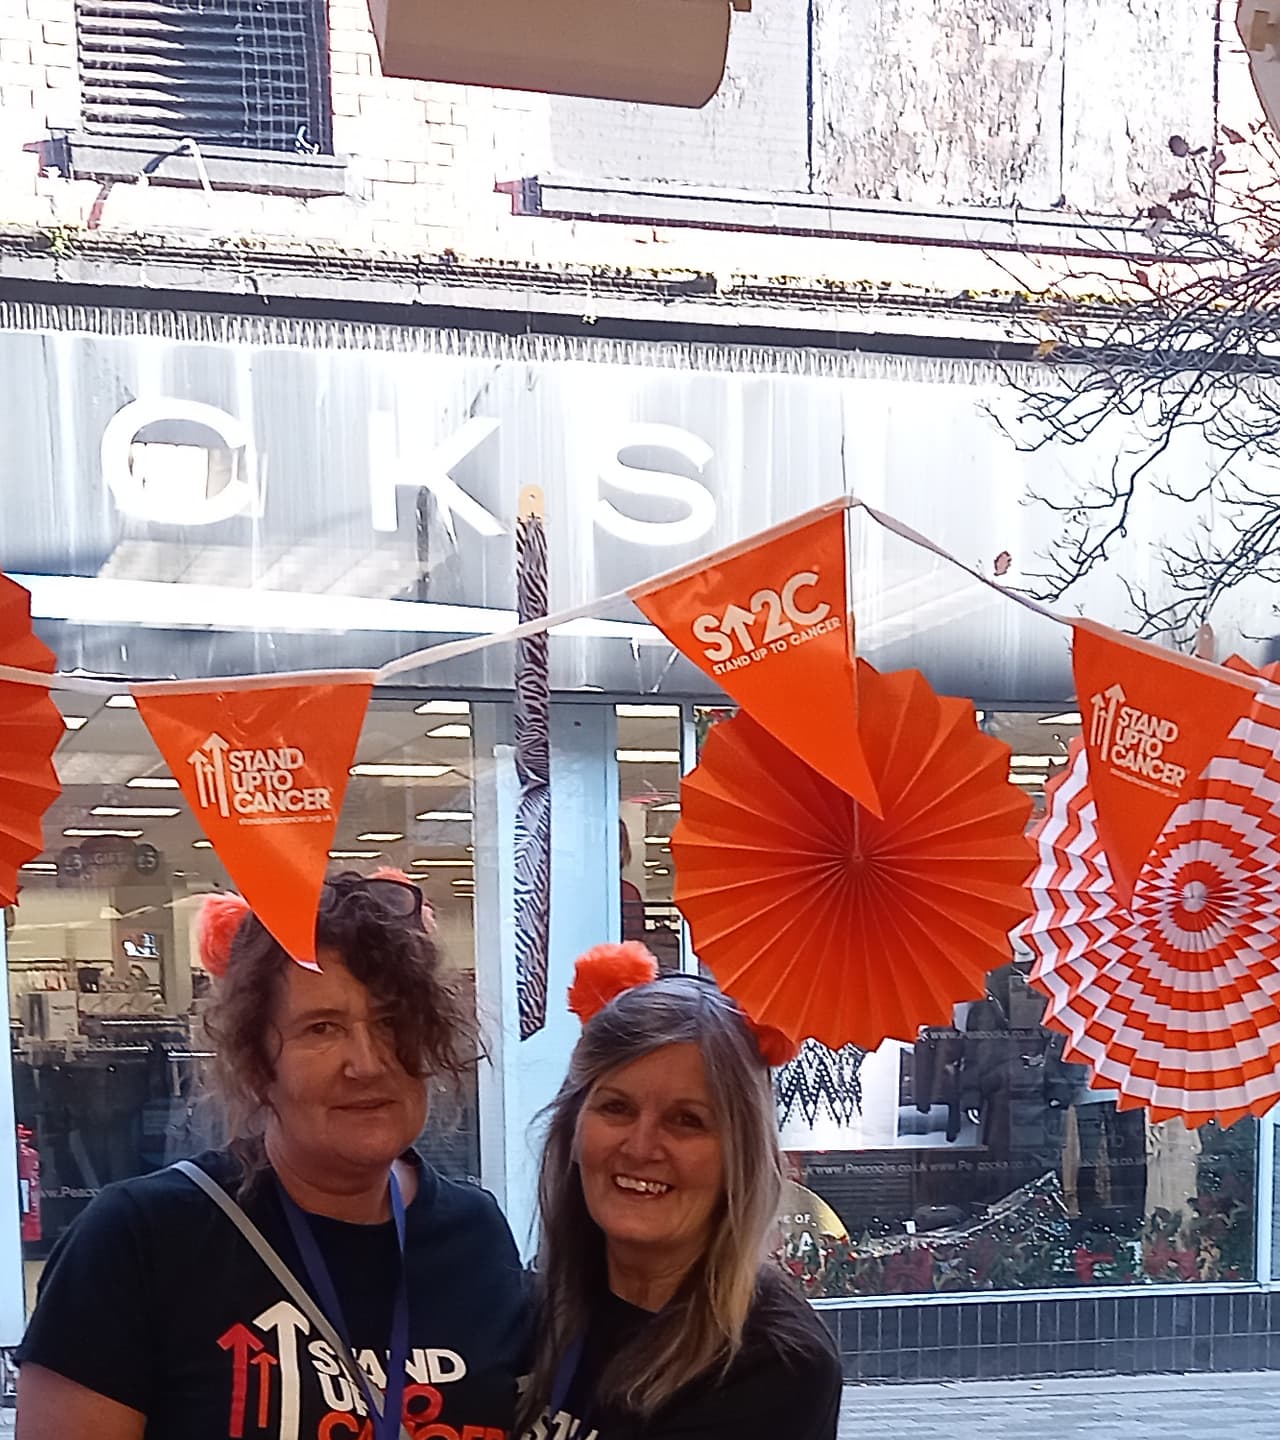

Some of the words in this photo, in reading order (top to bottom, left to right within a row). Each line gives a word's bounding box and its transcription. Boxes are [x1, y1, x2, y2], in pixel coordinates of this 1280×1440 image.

[713, 654, 752, 675] STAND
[751, 647, 768, 662] UP
[770, 640, 788, 654] TO
[790, 617, 841, 646] CANCER
[1118, 706, 1179, 742] STAND
[228, 748, 305, 772] STAND
[1111, 745, 1187, 788] CANCER
[234, 788, 332, 814] CANCER
[308, 1340, 467, 1389] SAND
